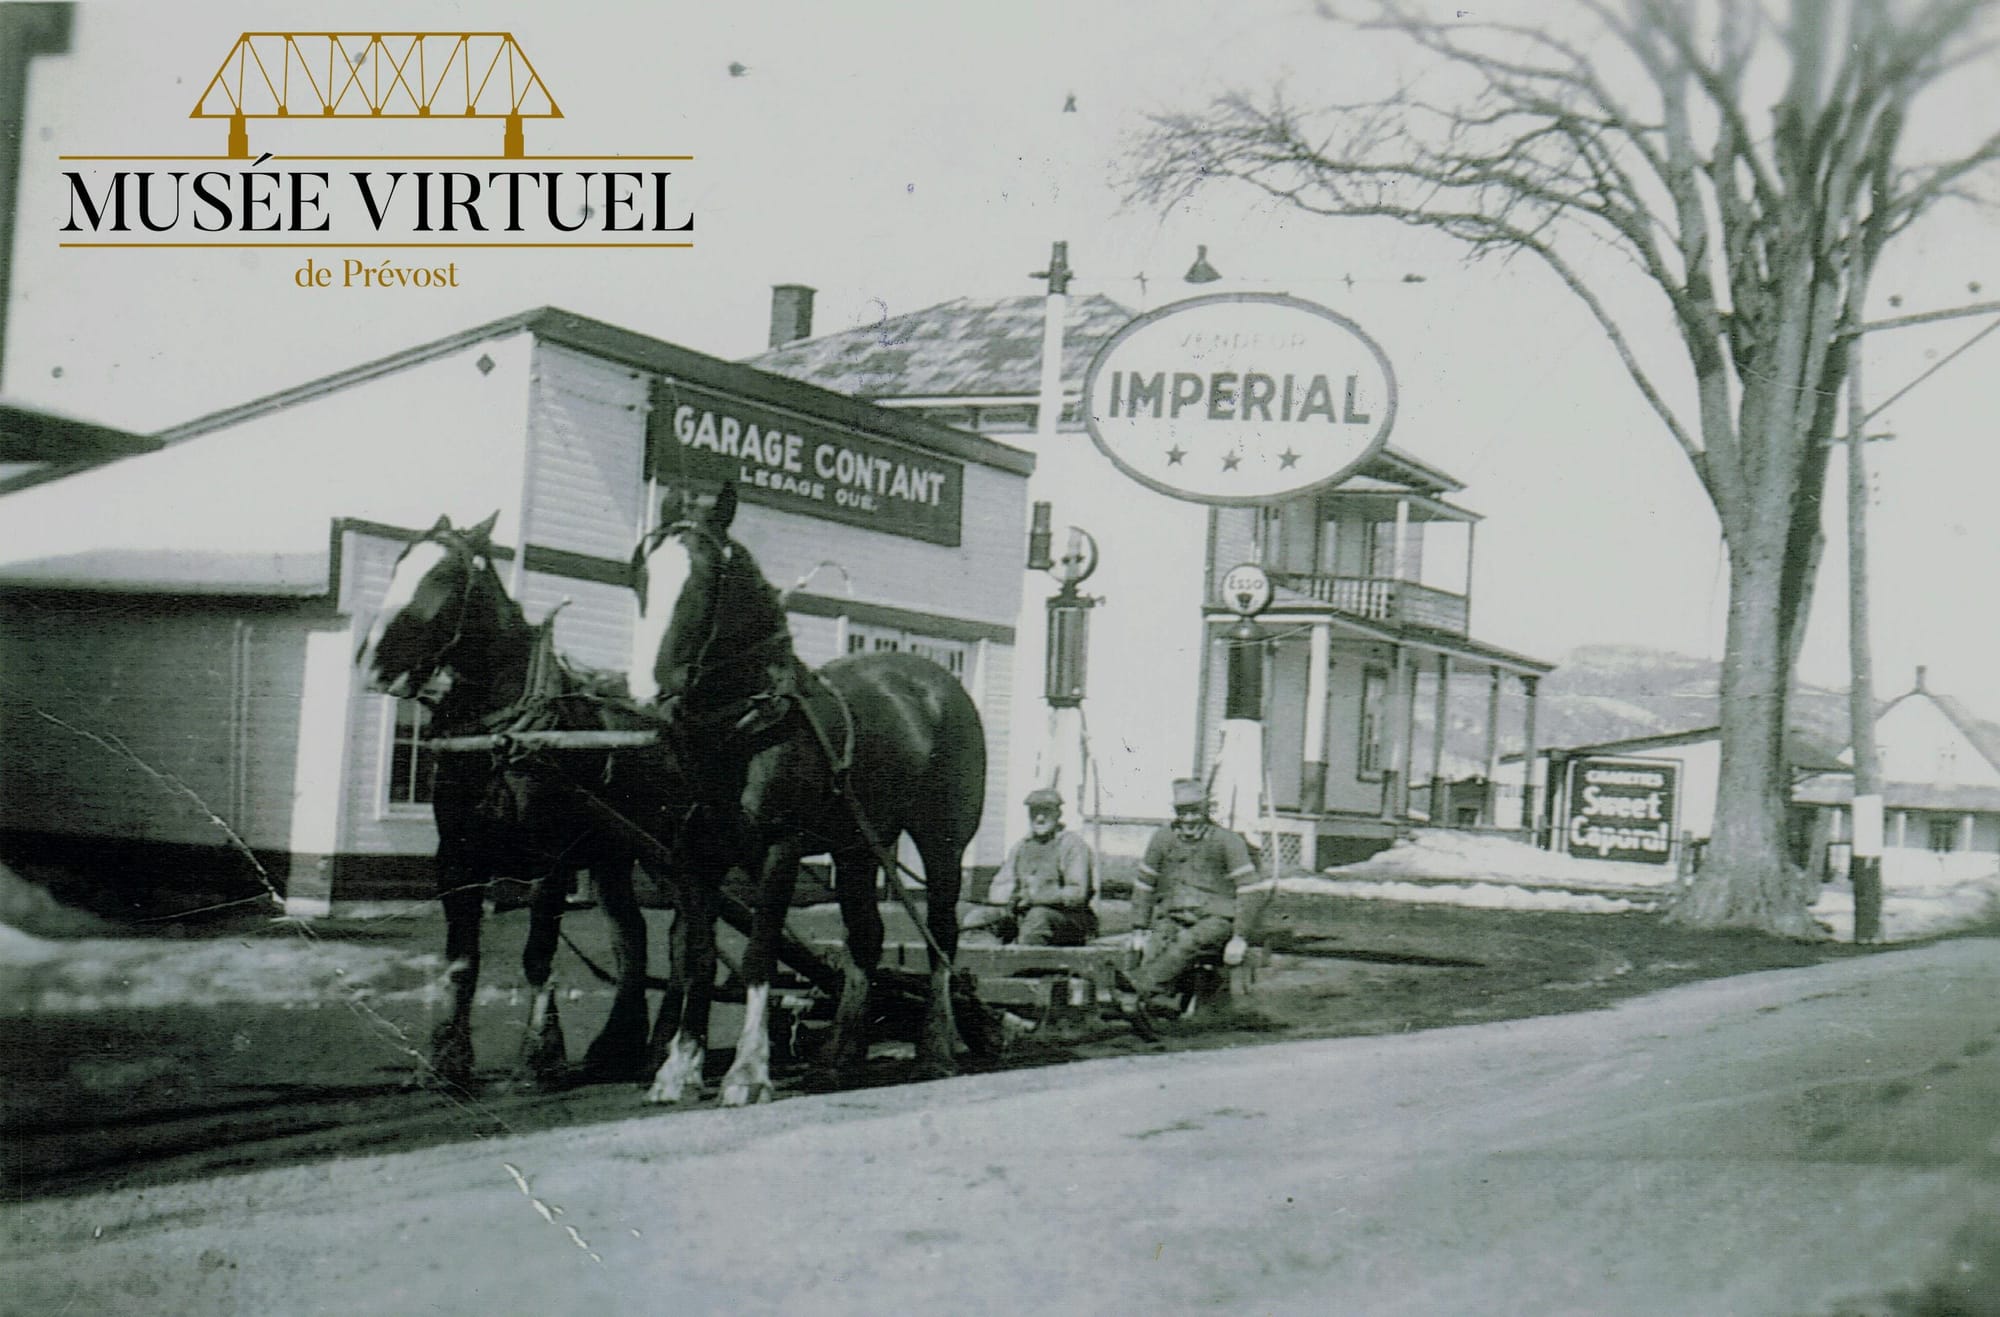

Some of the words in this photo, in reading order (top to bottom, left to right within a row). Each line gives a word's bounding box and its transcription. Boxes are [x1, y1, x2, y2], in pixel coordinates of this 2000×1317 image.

[1108, 370, 1371, 425] IMPERIAL
[673, 404, 804, 473] GARAGE
[814, 443, 946, 506] CONTANT
[739, 465, 825, 500] LESAGE
[1582, 785, 1663, 819] Sweet
[1571, 815, 1669, 856] Caporal
